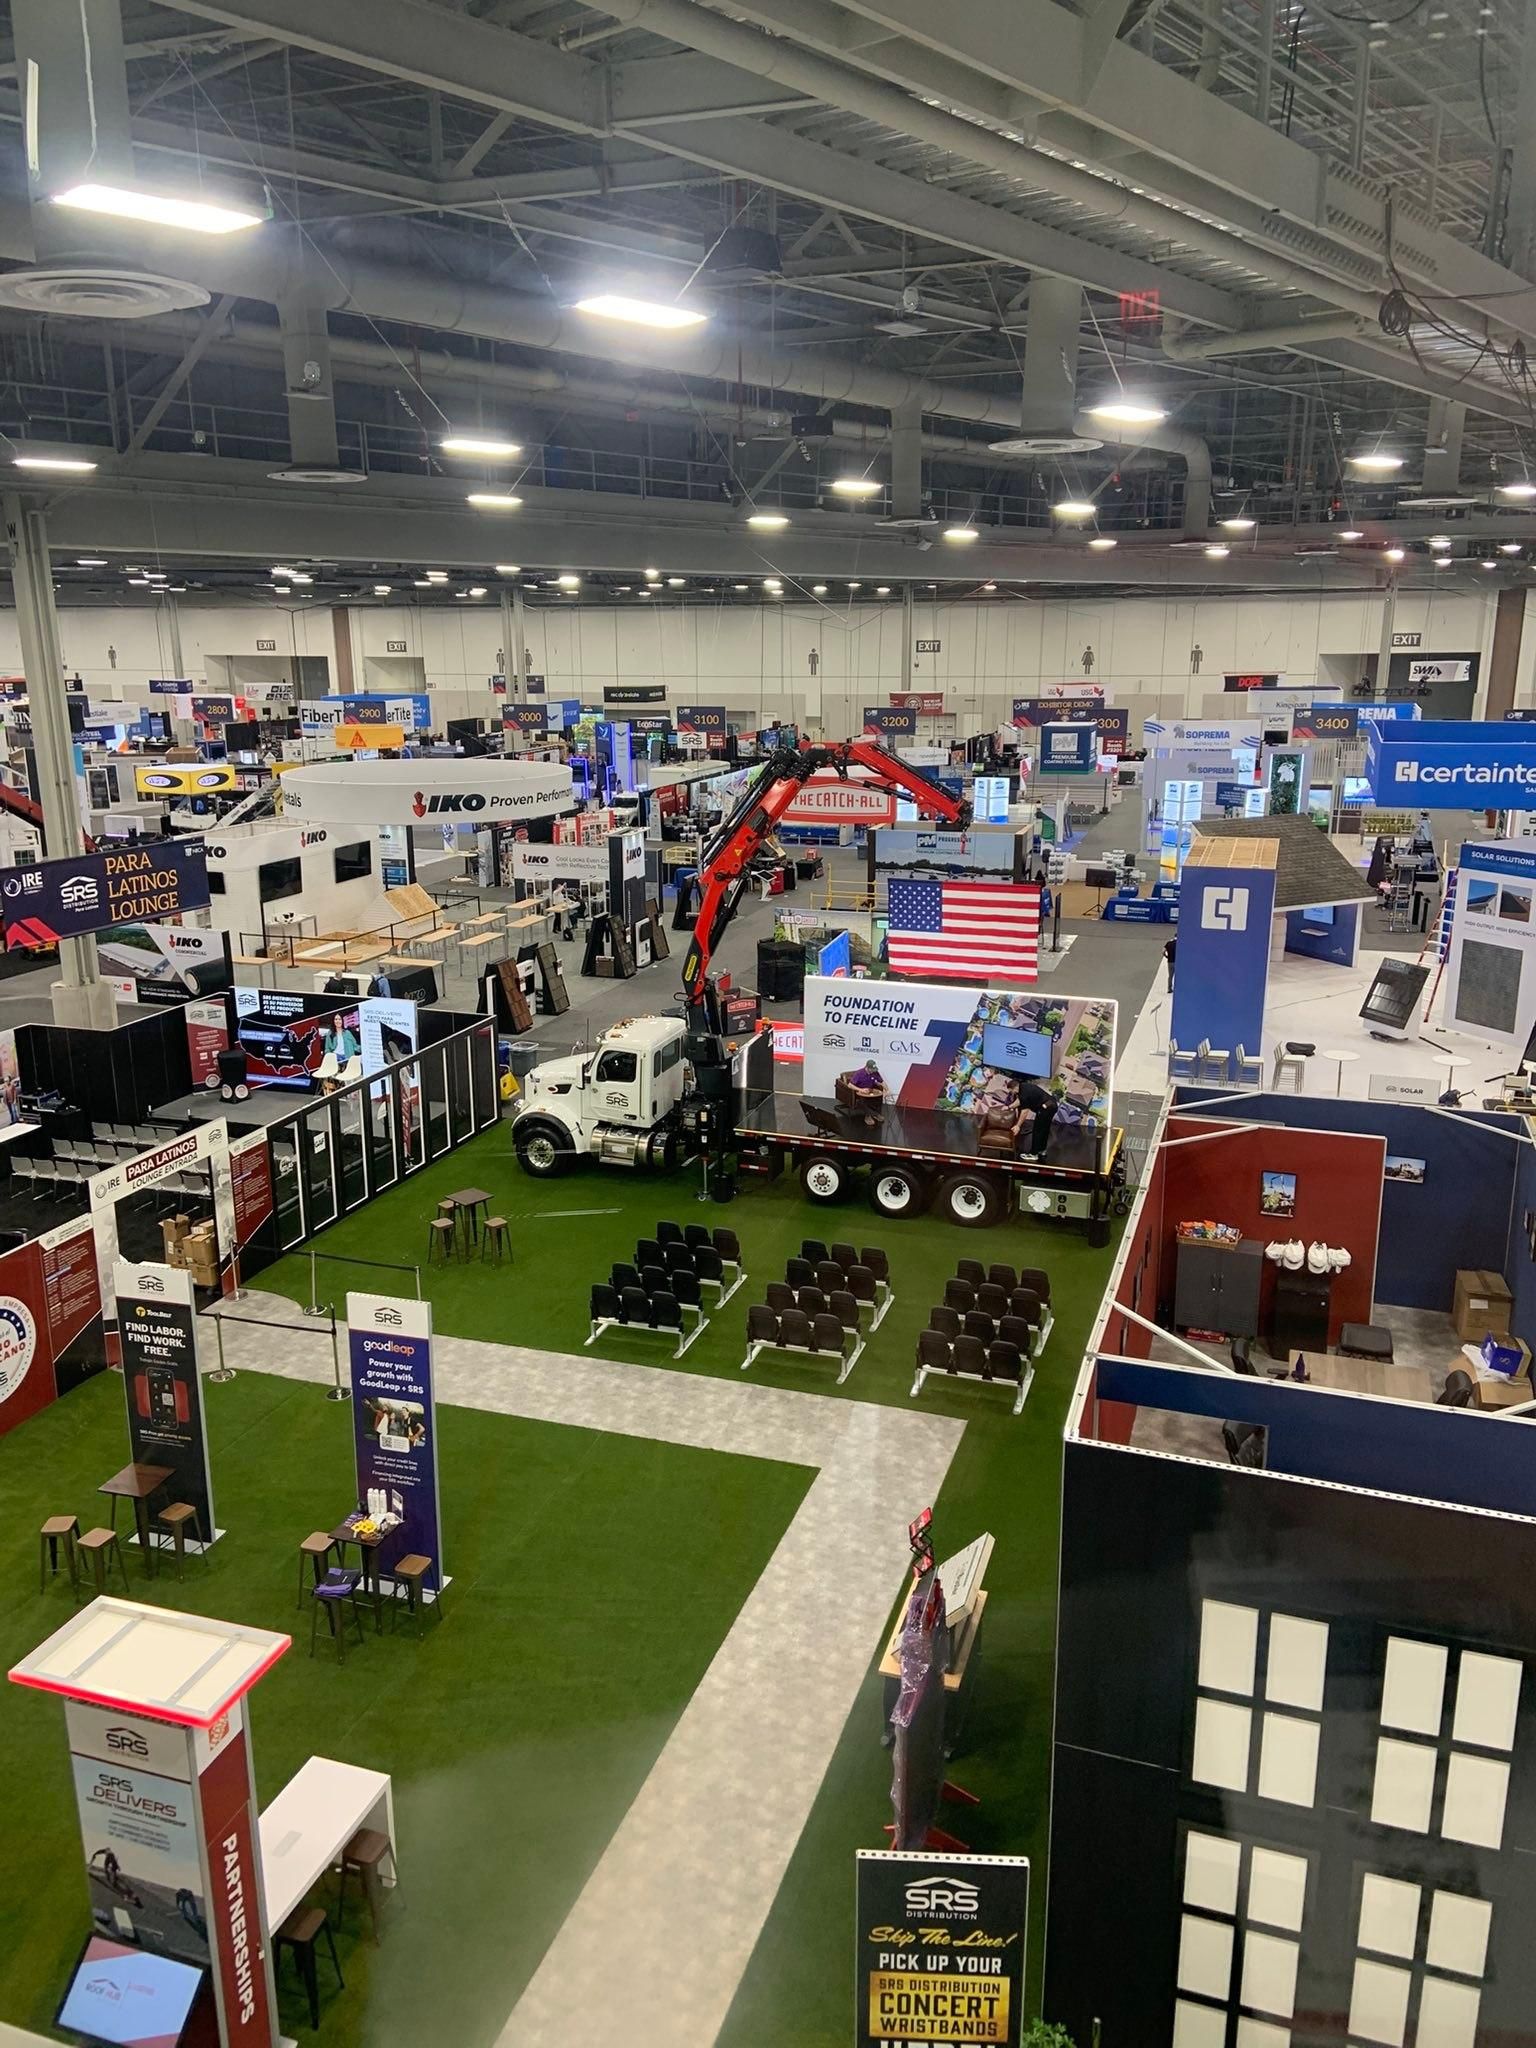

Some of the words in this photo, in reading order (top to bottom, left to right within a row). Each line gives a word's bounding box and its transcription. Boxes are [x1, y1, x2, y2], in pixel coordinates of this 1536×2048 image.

[258, 642, 275, 650] EXIT
[389, 642, 406, 651] EXIT
[918, 641, 940, 651] EXIT
[1393, 635, 1419, 645] EXIT
[1237, 677, 1264, 687] DOPE
[207, 704, 228, 715] 2800
[359, 708, 381, 718] 2900
[518, 712, 542, 722] 3000
[694, 714, 720, 725] 3100
[881, 715, 909, 727] 3200
[1315, 718, 1350, 729] 3400
[637, 720, 662, 729] EcoStar
[681, 736, 702, 746] SRS
[1185, 730, 1230, 739] SOPREMA
[1197, 766, 1234, 774] SOPREMA
[428, 793, 486, 813] IKO
[490, 794, 534, 808] Proven
[794, 794, 813, 806] THE
[816, 791, 883, 808] CATCH-ALL
[306, 829, 327, 844] IKO
[938, 836, 972, 844] PROGRESSVE
[206, 846, 227, 858] KO
[629, 846, 642, 860] IKO
[1471, 850, 1494, 861] SOLAR
[1495, 854, 1536, 867] SOLUTIONS
[105, 852, 153, 875] PARA
[528, 855, 549, 864] IKO
[569, 861, 595, 870] Reflective
[22, 871, 44, 888] IRE
[107, 869, 178, 899] LATINOS
[61, 882, 99, 904] SRS
[63, 898, 99, 910] DISTRIBUTION
[109, 891, 180, 921] LOUNGE
[1508, 928, 1536, 938] EFFICIENCY
[176, 936, 203, 948] IKO
[238, 998, 258, 1006] SRS
[824, 995, 915, 1014] FOUNDATION
[824, 1011, 842, 1023] TO
[844, 1013, 919, 1031] FENCELINE
[822, 1037, 846, 1048] SRS
[889, 1040, 921, 1054] GMS
[1005, 1045, 1028, 1057] SRS
[1400, 1087, 1424, 1095] SOLAR
[606, 1095, 629, 1108] SRS
[208, 1132, 222, 1143] SRS
[127, 1160, 155, 1179] PARA
[155, 1139, 196, 1168] LATINOS
[132, 1170, 163, 1190] LOUNGE
[164, 1152, 198, 1176] ENTRADA
[107, 1176, 121, 1190] IRE
[138, 1281, 165, 1292] SRS
[374, 1312, 403, 1325] SRS
[125, 1322, 149, 1333] FIND
[150, 1325, 186, 1338] LABOR.
[128, 1333, 151, 1344] FIND
[152, 1336, 186, 1348] WORK.
[144, 1345, 172, 1357] FREE.
[363, 1340, 415, 1357] goodleap
[368, 1358, 393, 1368] Power
[394, 1363, 413, 1371] your
[366, 1370, 395, 1381] growth
[396, 1373, 414, 1382] with
[359, 1378, 401, 1392] GoodLeap
[408, 1385, 424, 1394] SRS
[373, 1454, 387, 1462] Unlock
[396, 1457, 408, 1465] credit
[372, 1470, 392, 1478] Financing
[392, 1472, 412, 1481] integrated
[105, 1732, 149, 1756] SRS
[98, 1773, 133, 1793] SRS
[93, 1785, 178, 1818] DELIVERS
[86, 1796, 113, 1809] GROWTH
[113, 1803, 145, 1816] THROUGH
[144, 1811, 187, 1828] PARTNERSHIP
[905, 1889, 979, 1912] SRS
[906, 1911, 978, 1920] DISTRIBUTION
[222, 1832, 255, 2025] PARTNERSHIPS
[869, 1926, 917, 1948] Skip
[918, 1927, 952, 1945] The
[952, 1929, 1018, 1948] Line!
[879, 1953, 919, 1971] PICK
[927, 1955, 949, 1972] UP
[956, 1955, 1002, 1974] YOUR
[879, 1978, 904, 1991] SRS
[909, 1980, 1001, 1995] DISTRIBUTION
[879, 1992, 1000, 2020] CONCERT
[880, 2018, 998, 2036] WRISTBANDS
